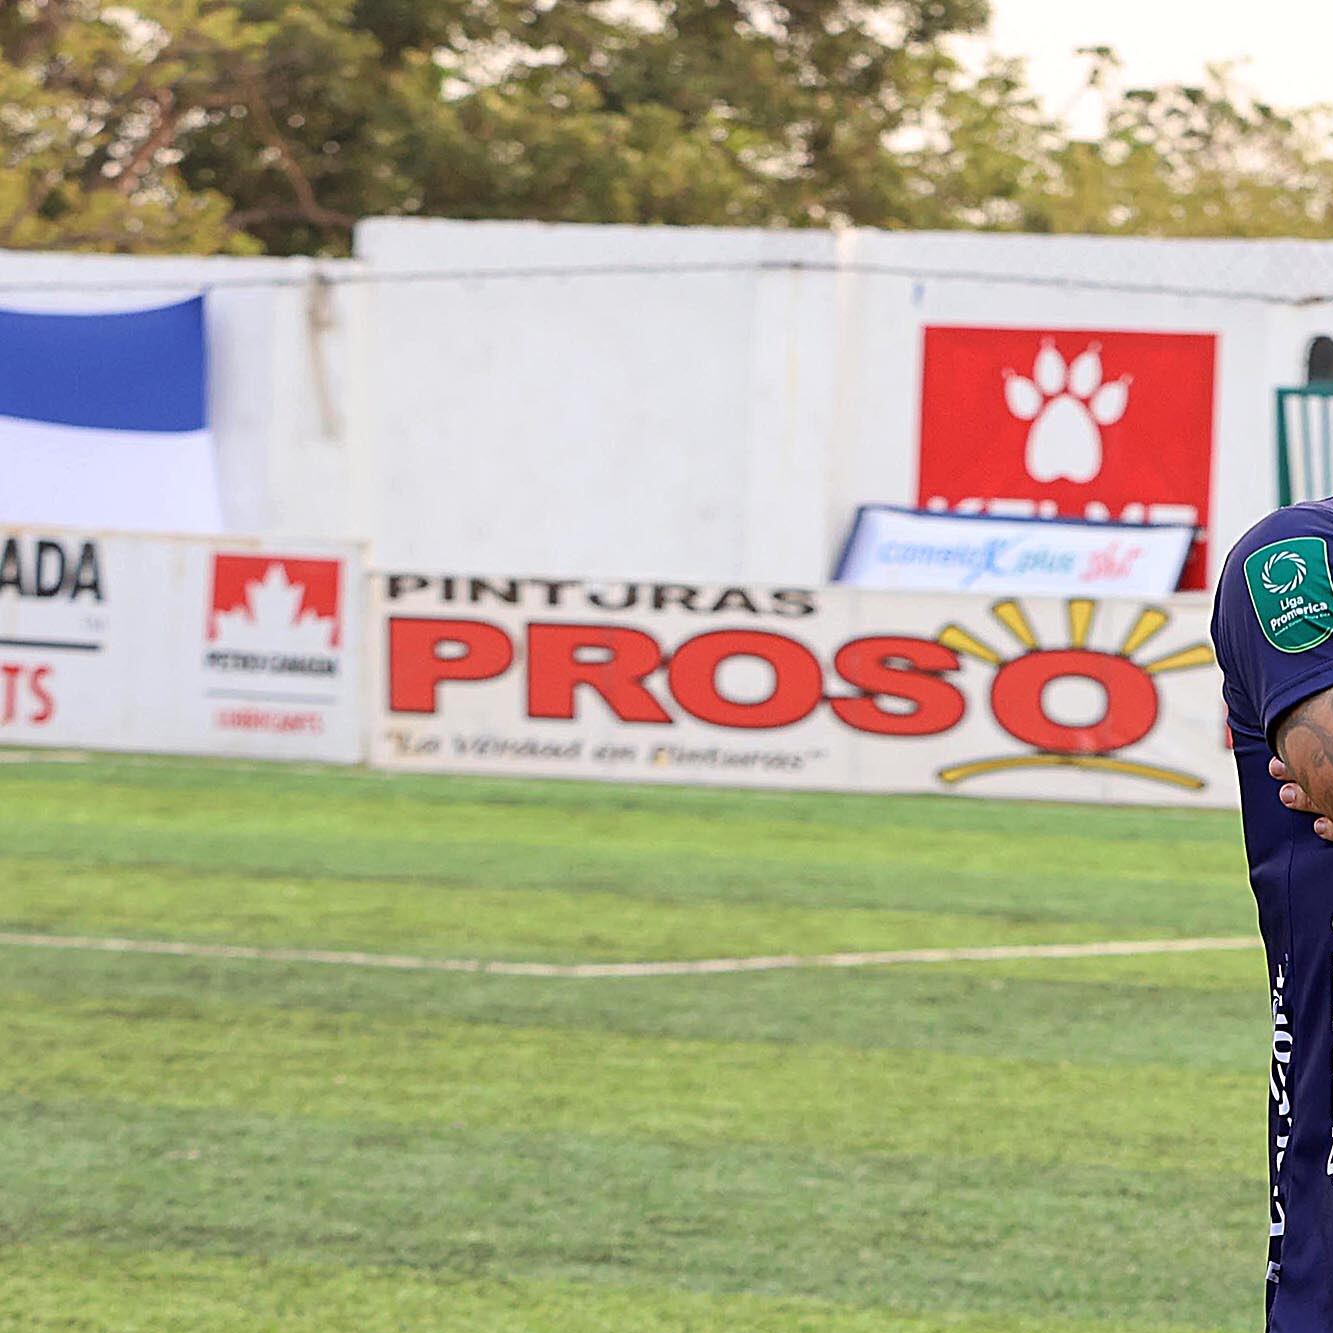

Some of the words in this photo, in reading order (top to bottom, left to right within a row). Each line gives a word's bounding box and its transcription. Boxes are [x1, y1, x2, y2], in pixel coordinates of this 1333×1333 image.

[1270, 602, 1328, 631] Promerica
[1279, 596, 1304, 611] Liga
[389, 616, 1159, 756] PROSO
